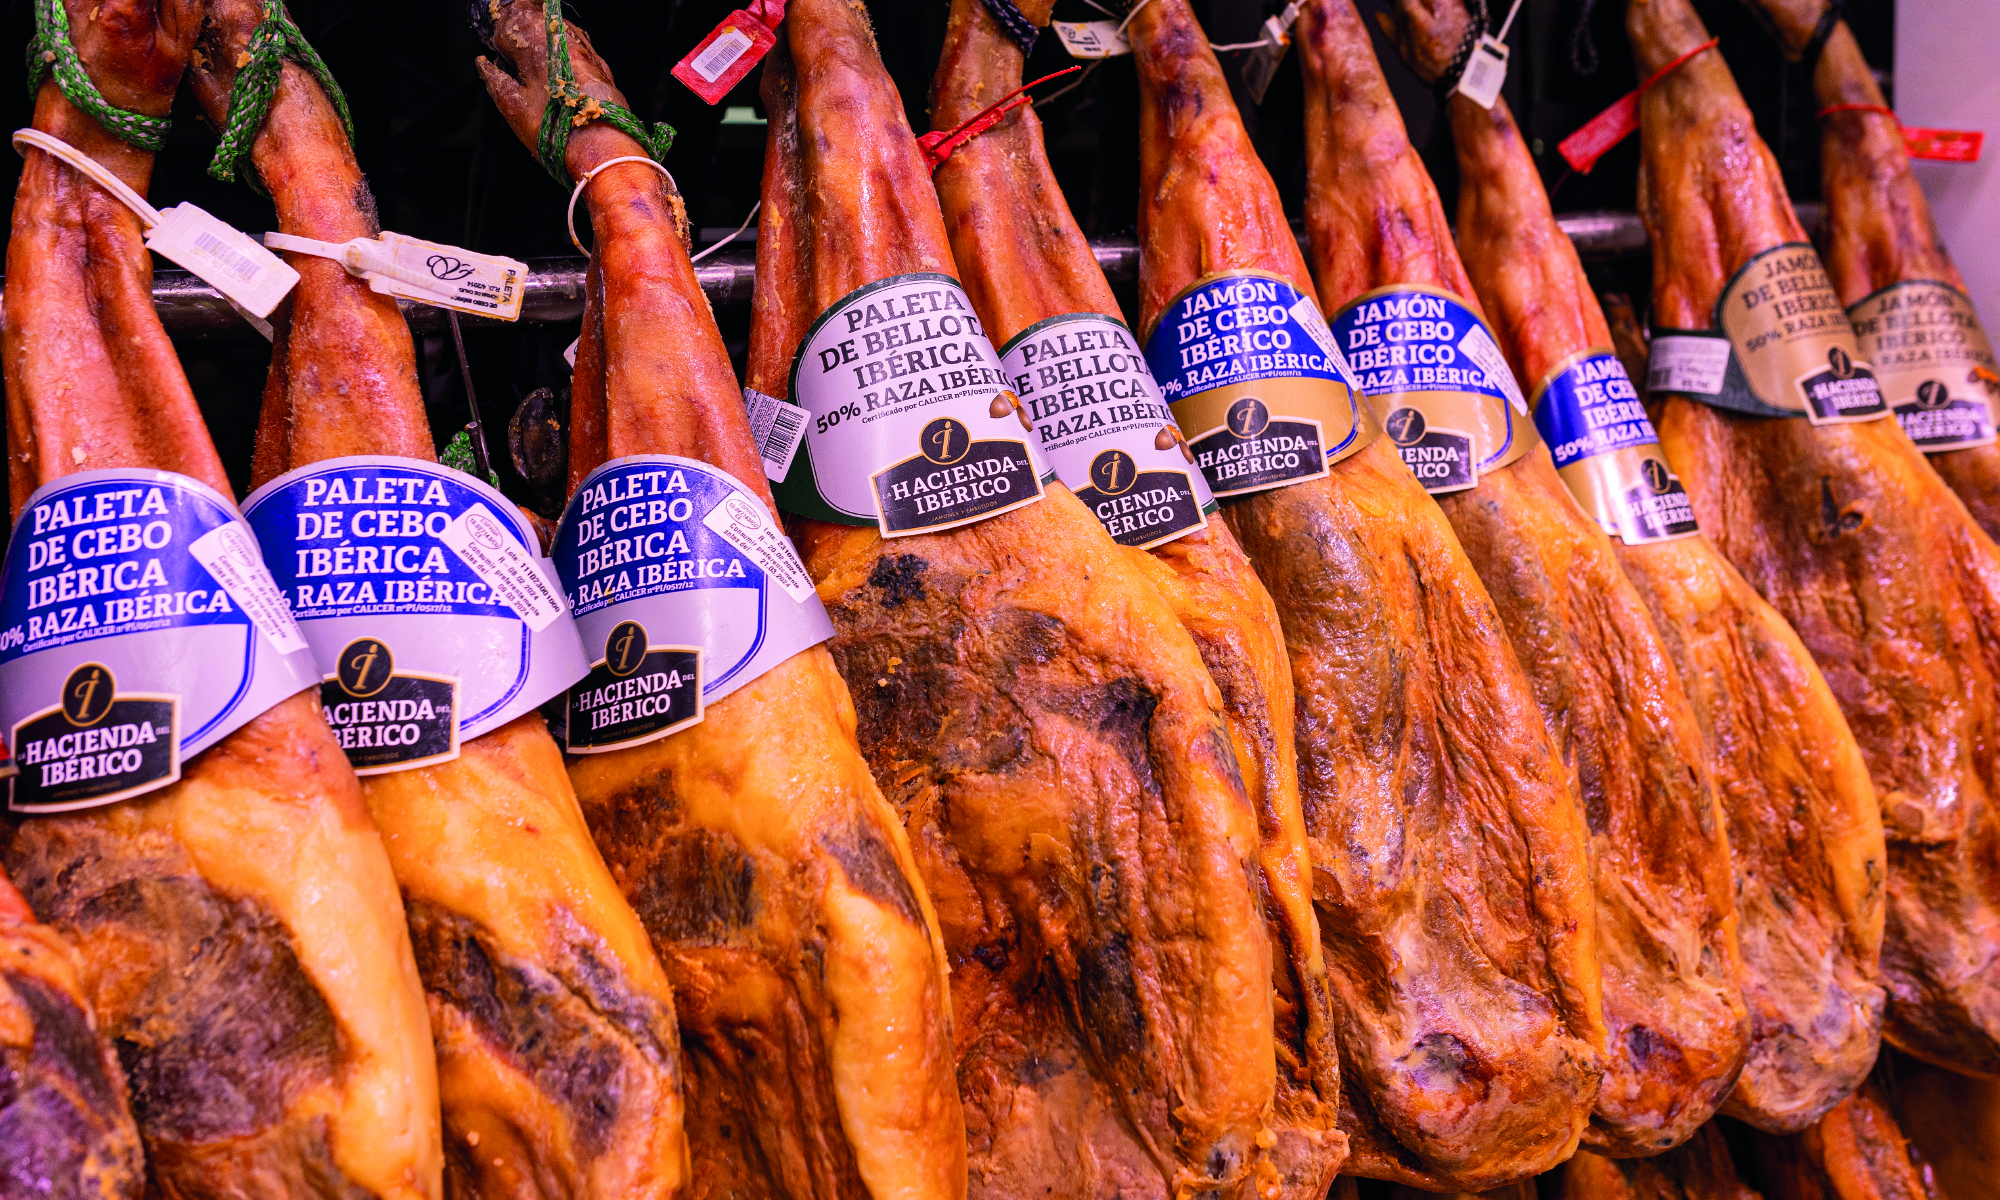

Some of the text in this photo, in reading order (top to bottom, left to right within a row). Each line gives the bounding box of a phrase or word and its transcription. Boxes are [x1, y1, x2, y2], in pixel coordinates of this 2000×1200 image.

[503, 269, 516, 303] PALETA
[1181, 279, 1276, 320] JAMÓN
[843, 290, 965, 334] PALETA
[1177, 305, 1288, 345] DE CEBO
[1354, 293, 1446, 326] JAMÓN
[818, 315, 987, 374] DE BELLOT
[1020, 330, 1130, 367] PALETA
[1180, 329, 1291, 369] IBÉRICO
[1349, 320, 1455, 349] DE CEBO
[852, 341, 985, 390] IBÉRICA
[1158, 350, 1337, 398] 0% RAZA IBÉRICA
[1348, 342, 1455, 372] IBÉRICO
[1574, 355, 1628, 385] JAMÓ
[1011, 373, 1034, 398] E
[1181, 372, 1260, 397] Certificado por CALICER
[1356, 365, 1496, 390] RAZA IBÉRICA
[1573, 382, 1608, 408] DE
[816, 402, 862, 436] 50%
[864, 377, 937, 412] RAZA
[861, 407, 903, 424] Certificado
[904, 402, 918, 413] por
[918, 393, 953, 407] CALICER
[1028, 379, 1149, 422] IBÉRICA
[1038, 410, 1104, 444] RAZA
[1045, 438, 1074, 452] rtificado
[1075, 435, 1088, 445] por
[1088, 426, 1121, 439] CALICER
[1554, 436, 1594, 462] 50%
[1592, 422, 1642, 446] RAZA
[1198, 435, 1308, 469] HACIENDA
[1216, 453, 1299, 481] IBÉRICO
[1398, 447, 1459, 462] IENDA
[303, 477, 450, 508] PALETA
[580, 469, 690, 515] PALETA
[891, 456, 1018, 501] HACIENDA
[914, 476, 1011, 515] IBÉRICO
[33, 487, 169, 535] PALETA
[1090, 486, 1182, 519] CIENDA
[296, 509, 452, 541] DE CEBO
[577, 497, 693, 547] DE CEBO
[1103, 506, 1174, 538] ÉRICO
[28, 520, 172, 572] DE CEBO
[295, 540, 450, 578] IBÉRICA
[461, 549, 477, 565] antes
[505, 547, 520, 563] Lote:
[577, 529, 691, 579] IBÉRICA
[723, 530, 738, 543] antes
[760, 558, 791, 588] 21.03.2024
[729, 522, 800, 589] Consumir preferentemente
[28, 558, 168, 610] IBÉRICA
[296, 581, 378, 608] RAZA
[383, 575, 509, 606] IBÉRICA
[468, 541, 540, 617] Consumir preferentemente
[578, 556, 746, 606] RAZA IBÉRICA
[291, 606, 337, 618] Certificado
[337, 607, 352, 616] por
[353, 603, 394, 614] CALICER
[574, 581, 694, 616] Certificado por CALICER nºPI/0517/12
[0, 624, 25, 651] 0%
[28, 604, 99, 641] RAZA
[104, 589, 232, 625] IBÉRICA
[579, 669, 683, 712] HACIENDA
[682, 673, 695, 681] DEL
[322, 699, 436, 725] ACIENDA
[591, 693, 671, 730] IBÉRICO
[25, 721, 157, 765] HACIENDA
[332, 723, 420, 749] BÉRICO
[40, 749, 142, 788] IBÉRICO
